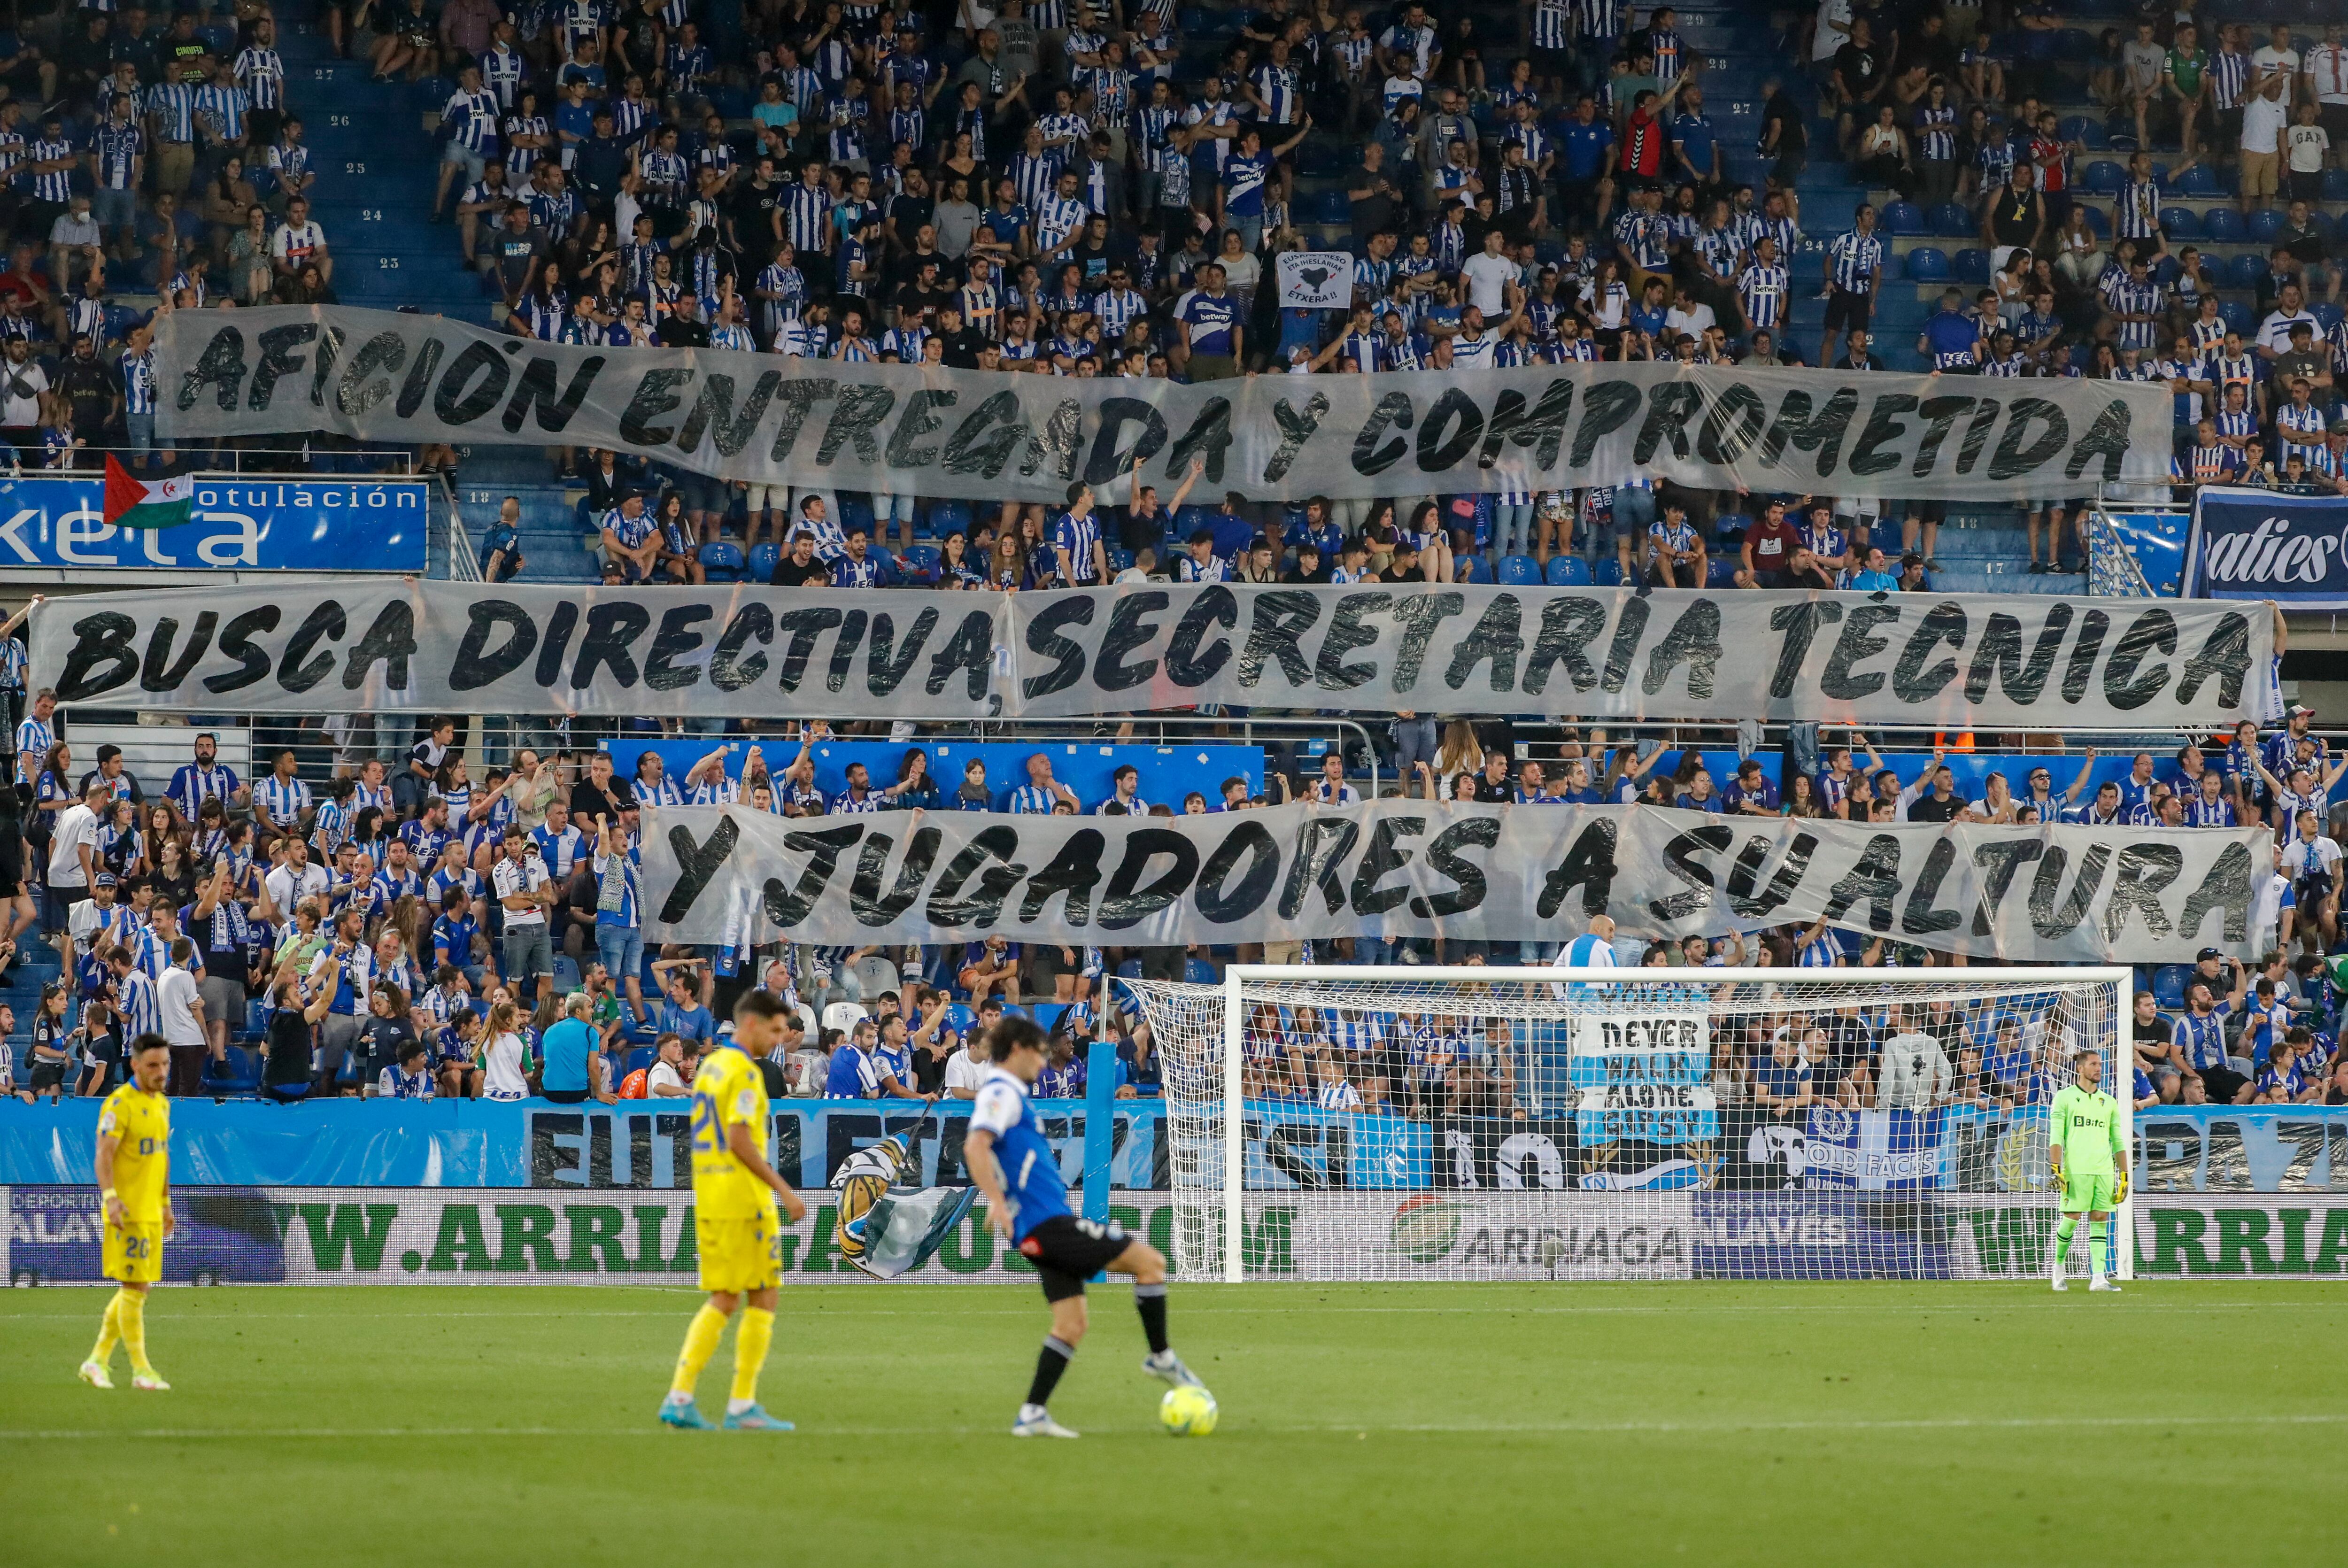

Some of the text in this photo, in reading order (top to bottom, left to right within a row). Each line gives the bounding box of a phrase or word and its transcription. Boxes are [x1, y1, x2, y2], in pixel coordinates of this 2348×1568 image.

[570, 19, 595, 27] betway
[1686, 15, 1703, 24] 29
[1709, 59, 1727, 70] 28
[316, 69, 333, 79] 27
[492, 73, 517, 81] betway
[1732, 103, 1750, 114] 27
[331, 116, 349, 126] 26
[2296, 131, 2321, 144] GAP
[347, 162, 365, 173] 25
[1236, 170, 1261, 182] betway
[363, 210, 382, 221] 24
[1806, 240, 1823, 251] 24
[380, 258, 399, 268] 23
[1287, 259, 1343, 273] ETA IHESLARIAK
[1287, 290, 1328, 303] ETXERA
[1200, 313, 1230, 322] betway
[1945, 353, 1971, 363] LEA
[177, 323, 2133, 486] AFICIÓN ENTREGADA Y COMPROMETIDA
[198, 486, 417, 508] otulación
[474, 492, 489, 503] 18
[1959, 517, 1977, 529] 18
[2205, 517, 2339, 583] aties
[1986, 563, 2004, 574] 17
[56, 588, 2253, 716] BUSCA DIRECTIVA, SECRETARÍA TÉCNICA
[409, 843, 438, 859] LEA
[658, 814, 2254, 942] Y JUGADORES A SU ALTURA
[1602, 1054, 1686, 1079] WALK
[490, 1089, 521, 1100] LEA
[1050, 1082, 1076, 1098] LEA
[690, 1090, 728, 1152] 21
[2085, 1119, 2105, 1128] Bitci
[1808, 1143, 1935, 1178] OLD FACES
[1807, 1177, 1821, 1189] OLD
[126, 1236, 149, 1260] 20
